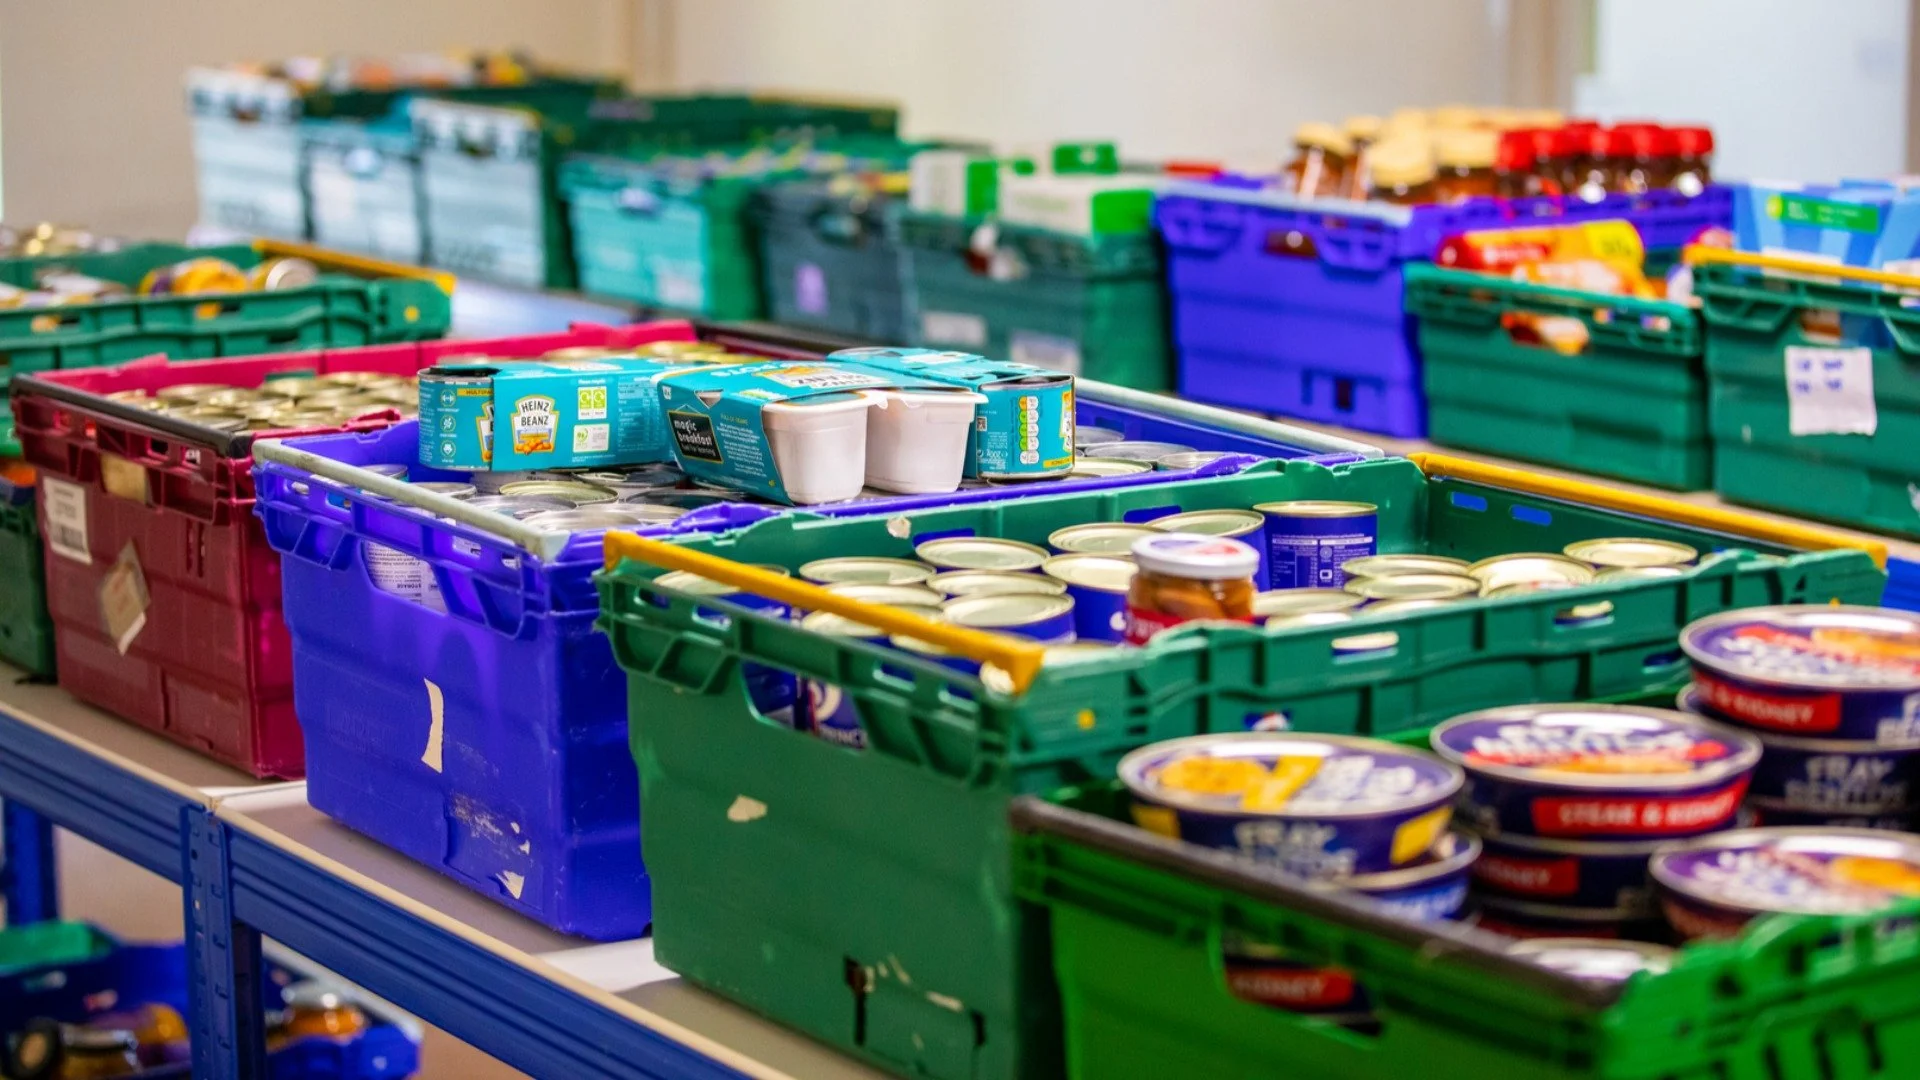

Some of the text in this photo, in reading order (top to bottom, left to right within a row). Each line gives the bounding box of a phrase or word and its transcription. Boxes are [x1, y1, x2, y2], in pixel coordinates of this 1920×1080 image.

[521, 400, 550, 412] HEINZ
[521, 416, 549, 426] BEANZ
[674, 420, 697, 434] magic
[677, 431, 713, 446] breakfast
[1558, 802, 1636, 826] STEAK
